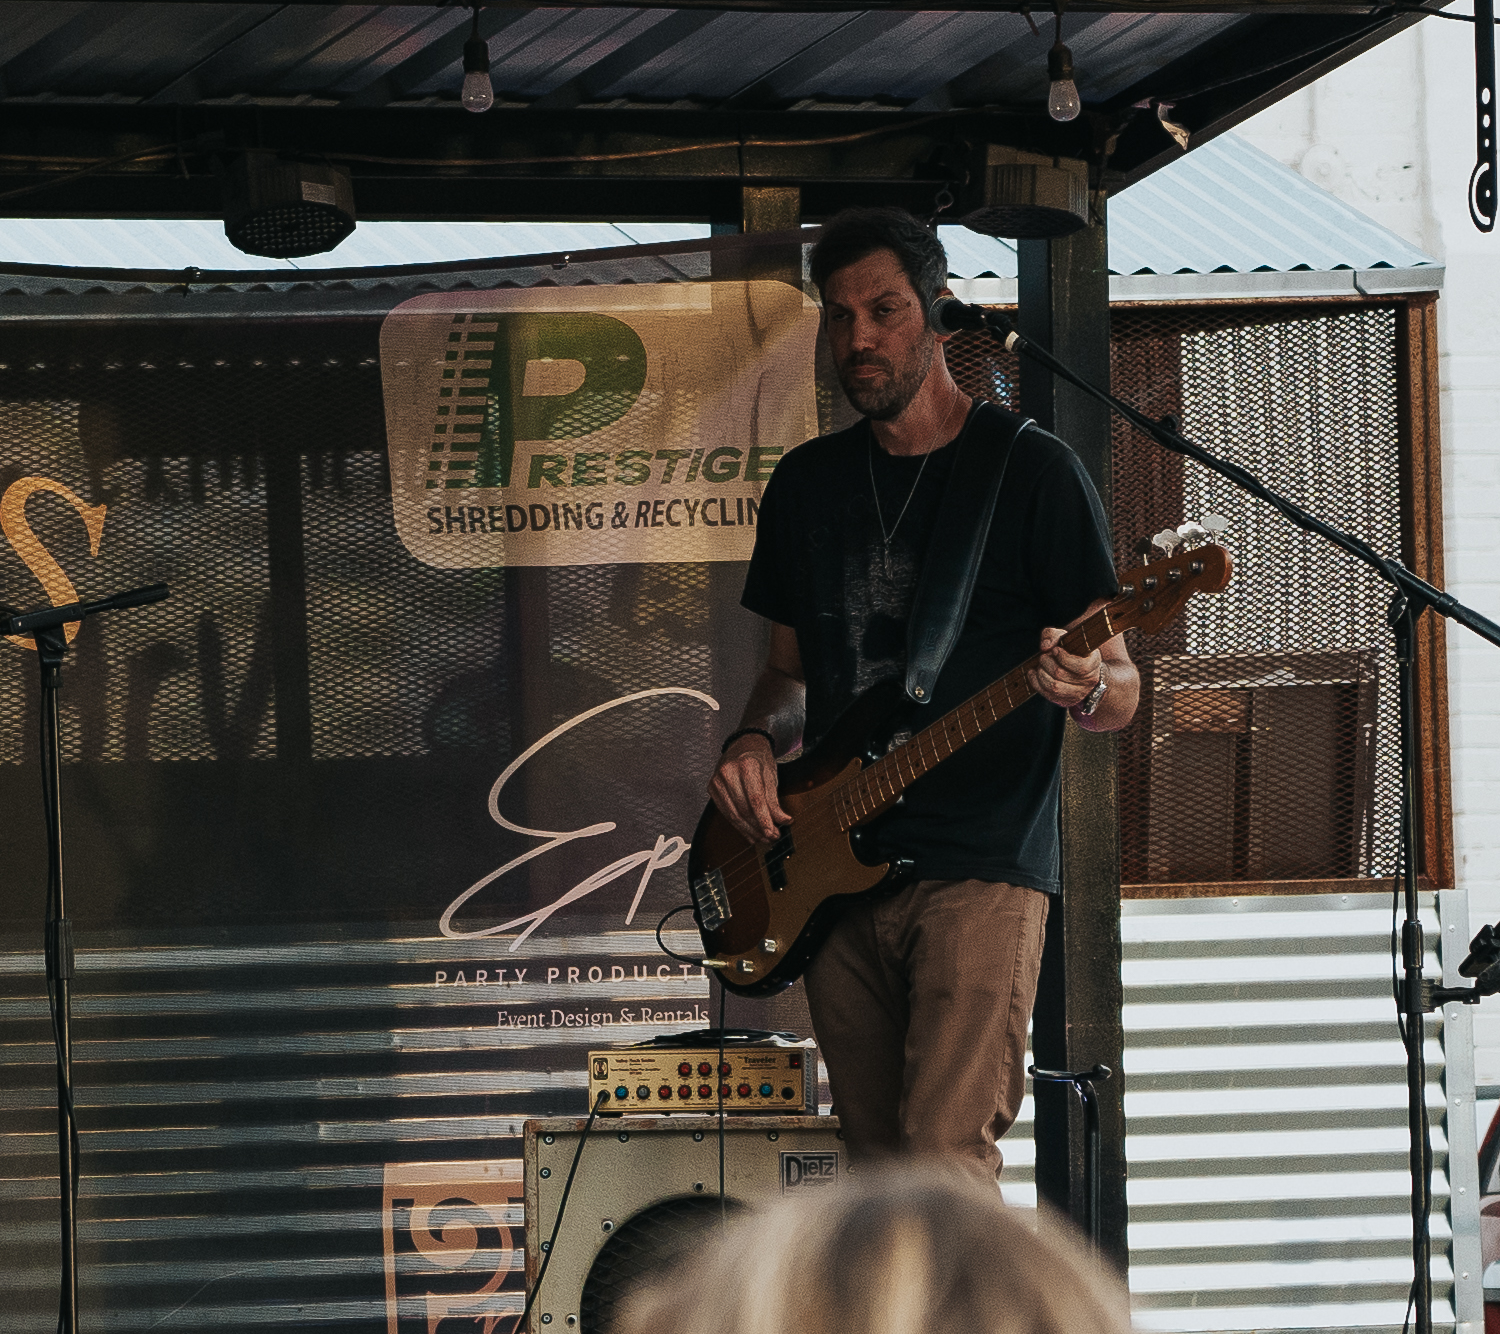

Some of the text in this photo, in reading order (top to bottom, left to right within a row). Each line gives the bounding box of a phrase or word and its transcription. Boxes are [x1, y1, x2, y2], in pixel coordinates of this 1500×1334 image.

[426, 312, 785, 489] PRESTIGE
[428, 496, 762, 535] SHREDDING & RECYCLIN
[434, 965, 709, 988] PARTY PRODUCTI
[497, 1003, 710, 1031] Event Design & Rentals
